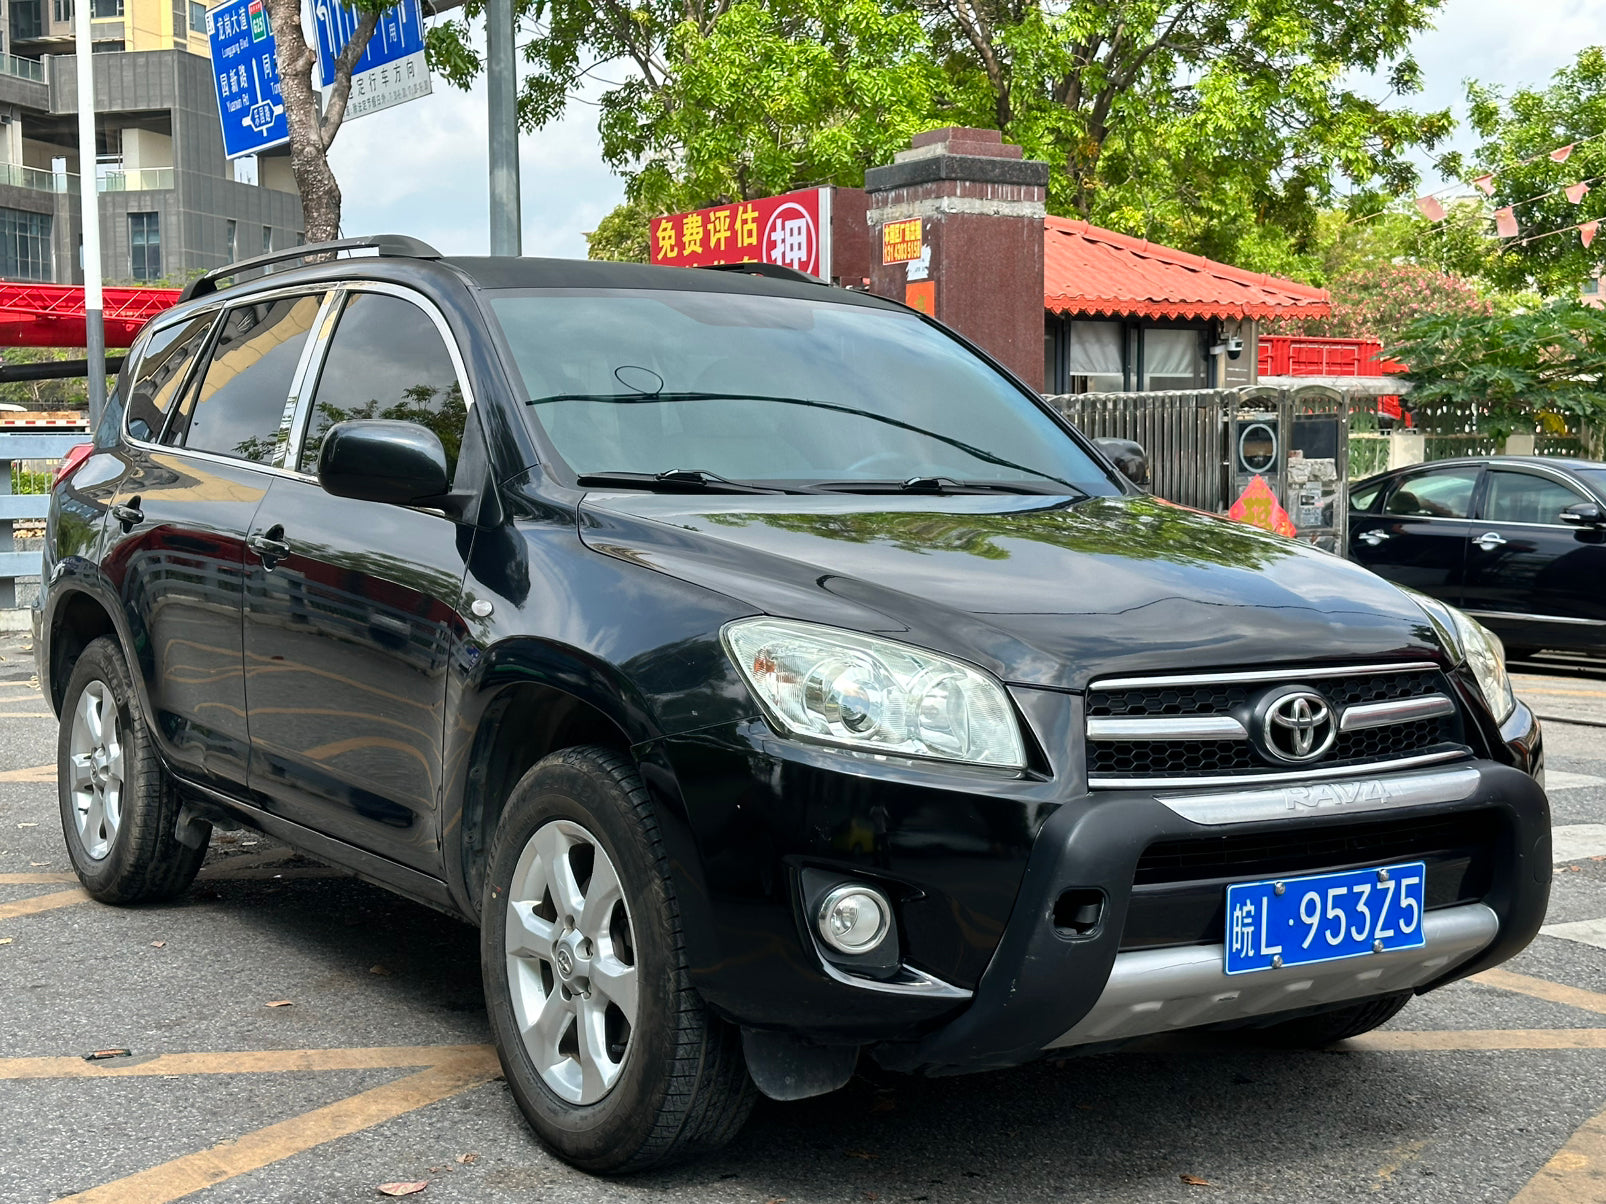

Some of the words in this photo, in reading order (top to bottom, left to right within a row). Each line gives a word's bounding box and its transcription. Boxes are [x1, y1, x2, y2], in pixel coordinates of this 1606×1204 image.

[217, 6, 248, 40] 龙岗大道
[253, 18, 263, 33] G25
[349, 59, 415, 99] 定行车方向
[656, 203, 759, 260] 免费评估
[771, 217, 807, 269] 押
[1282, 780, 1391, 810] RAV4
